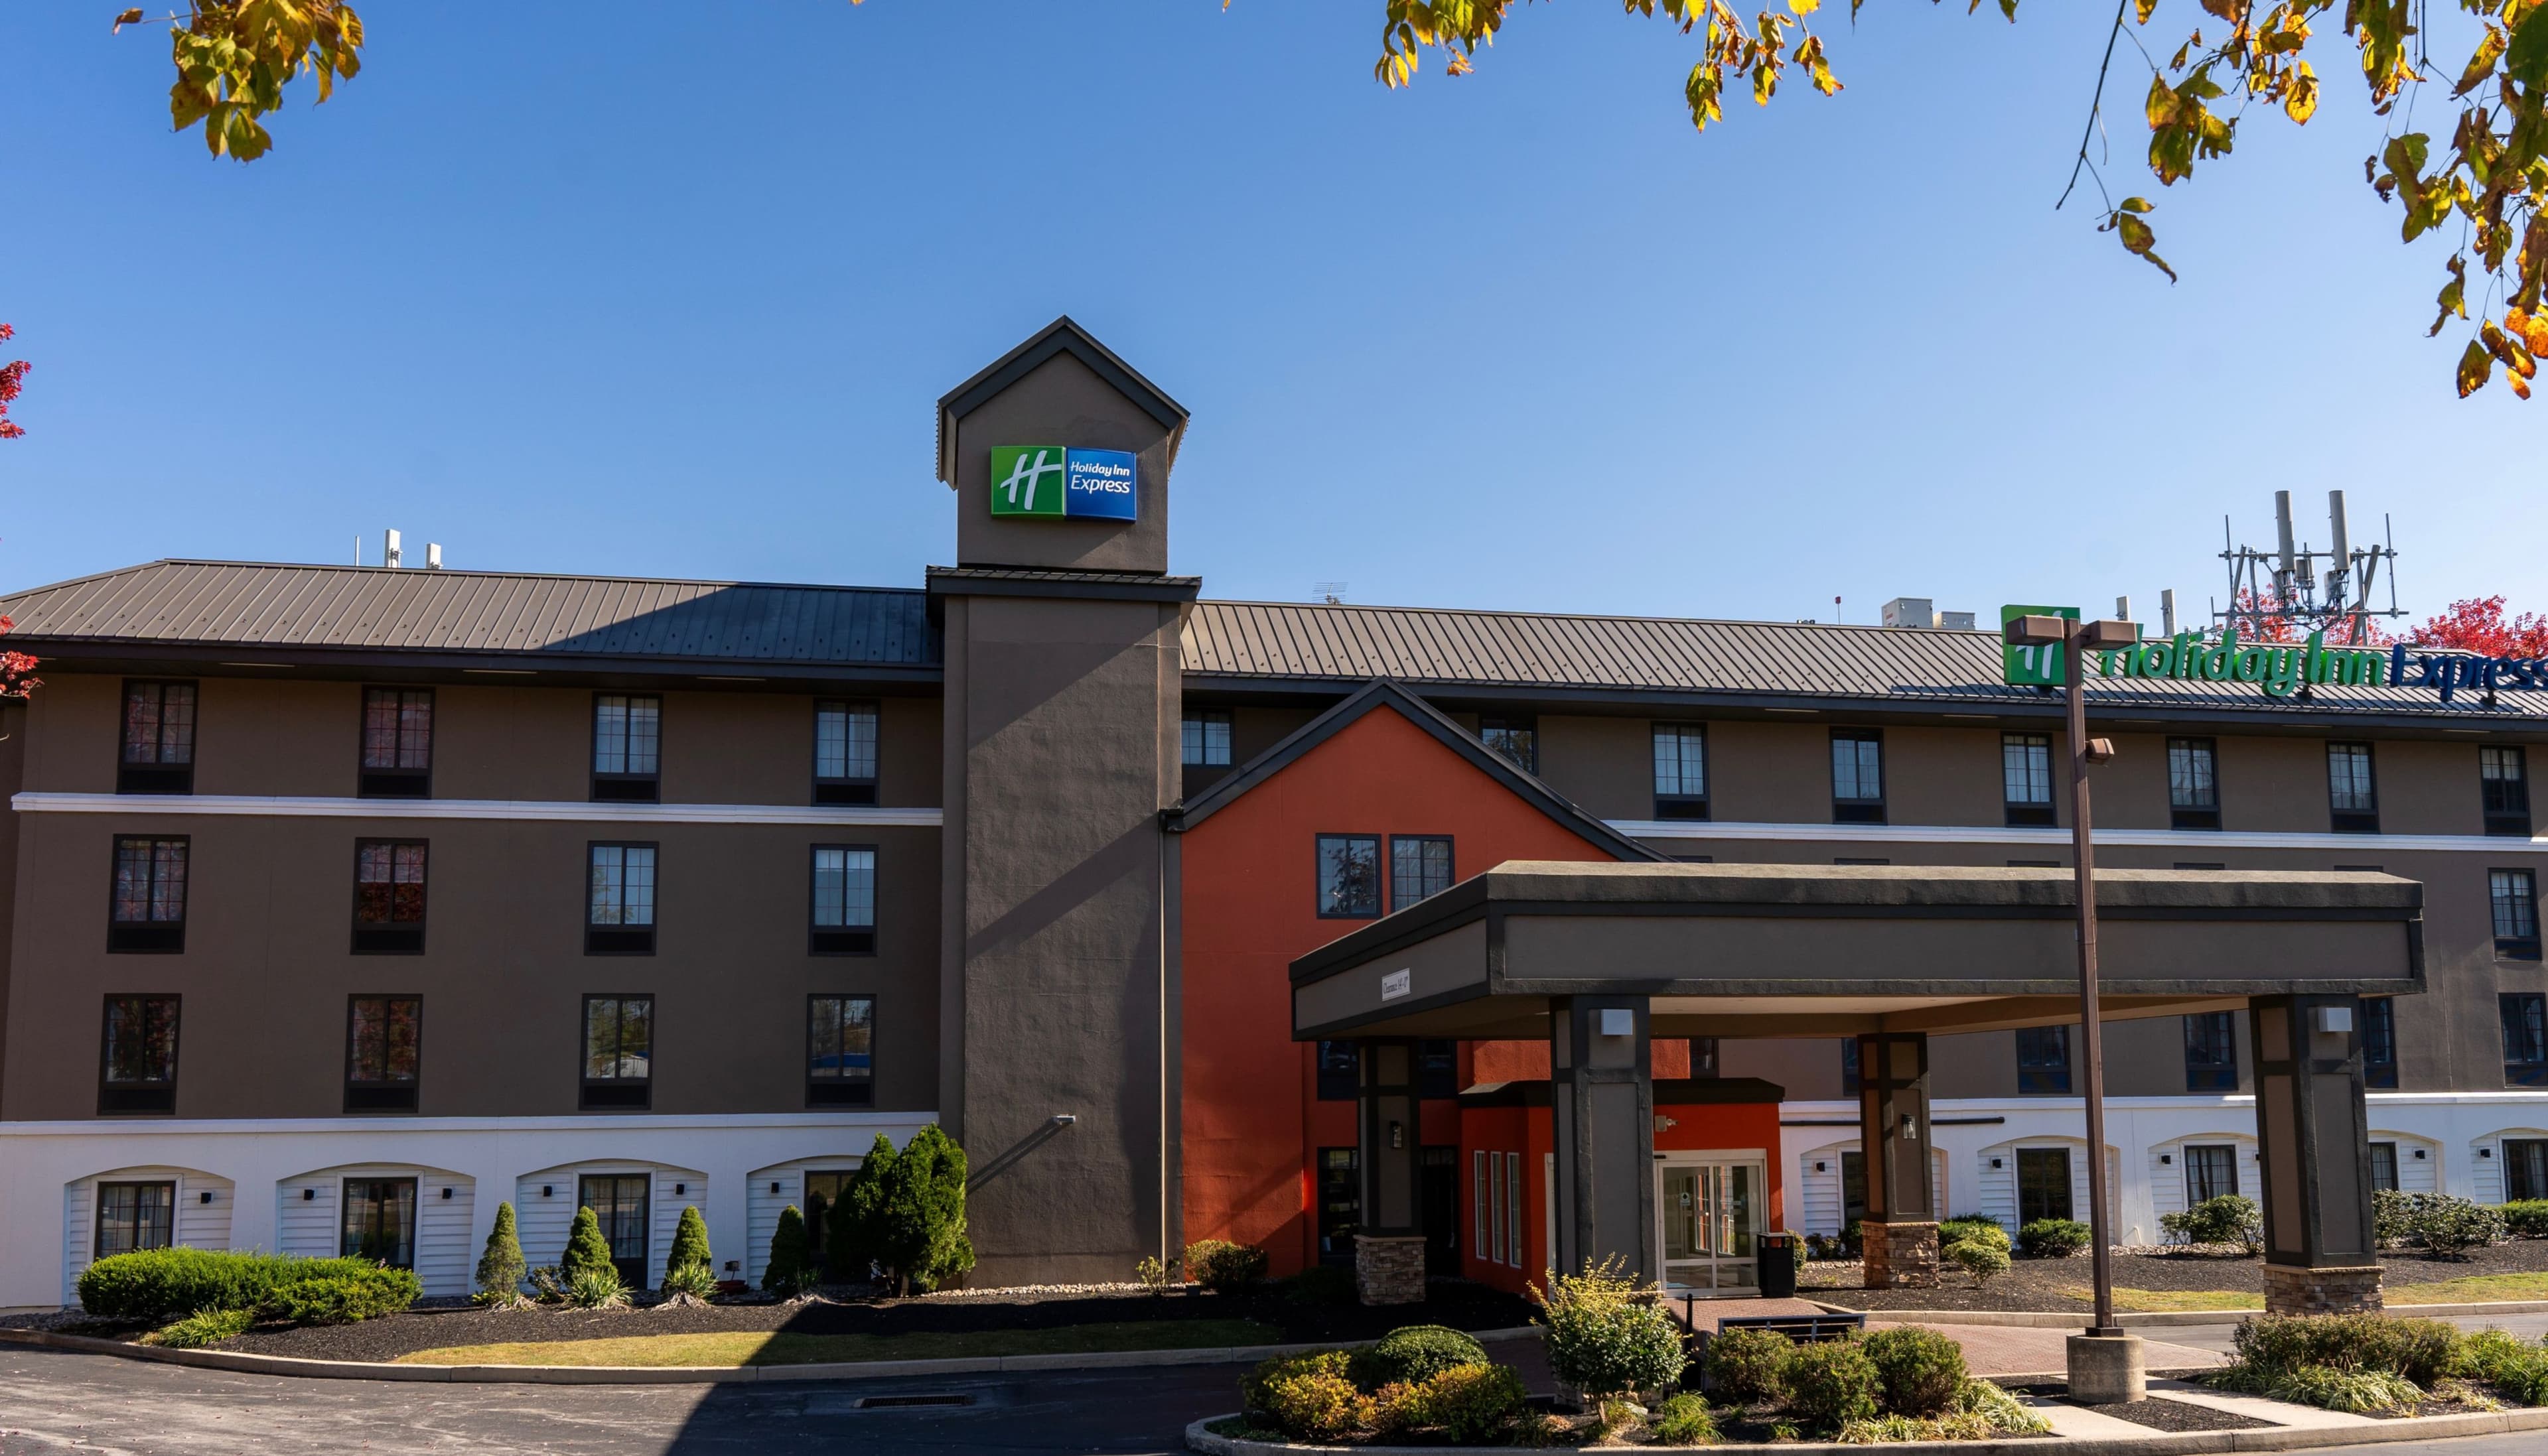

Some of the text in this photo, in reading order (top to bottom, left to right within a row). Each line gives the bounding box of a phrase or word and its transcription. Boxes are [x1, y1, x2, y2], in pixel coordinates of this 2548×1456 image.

[1070, 461, 1130, 476] Holiday Inn
[1070, 475, 1131, 494] Express
[2303, 630, 2385, 686] Inn
